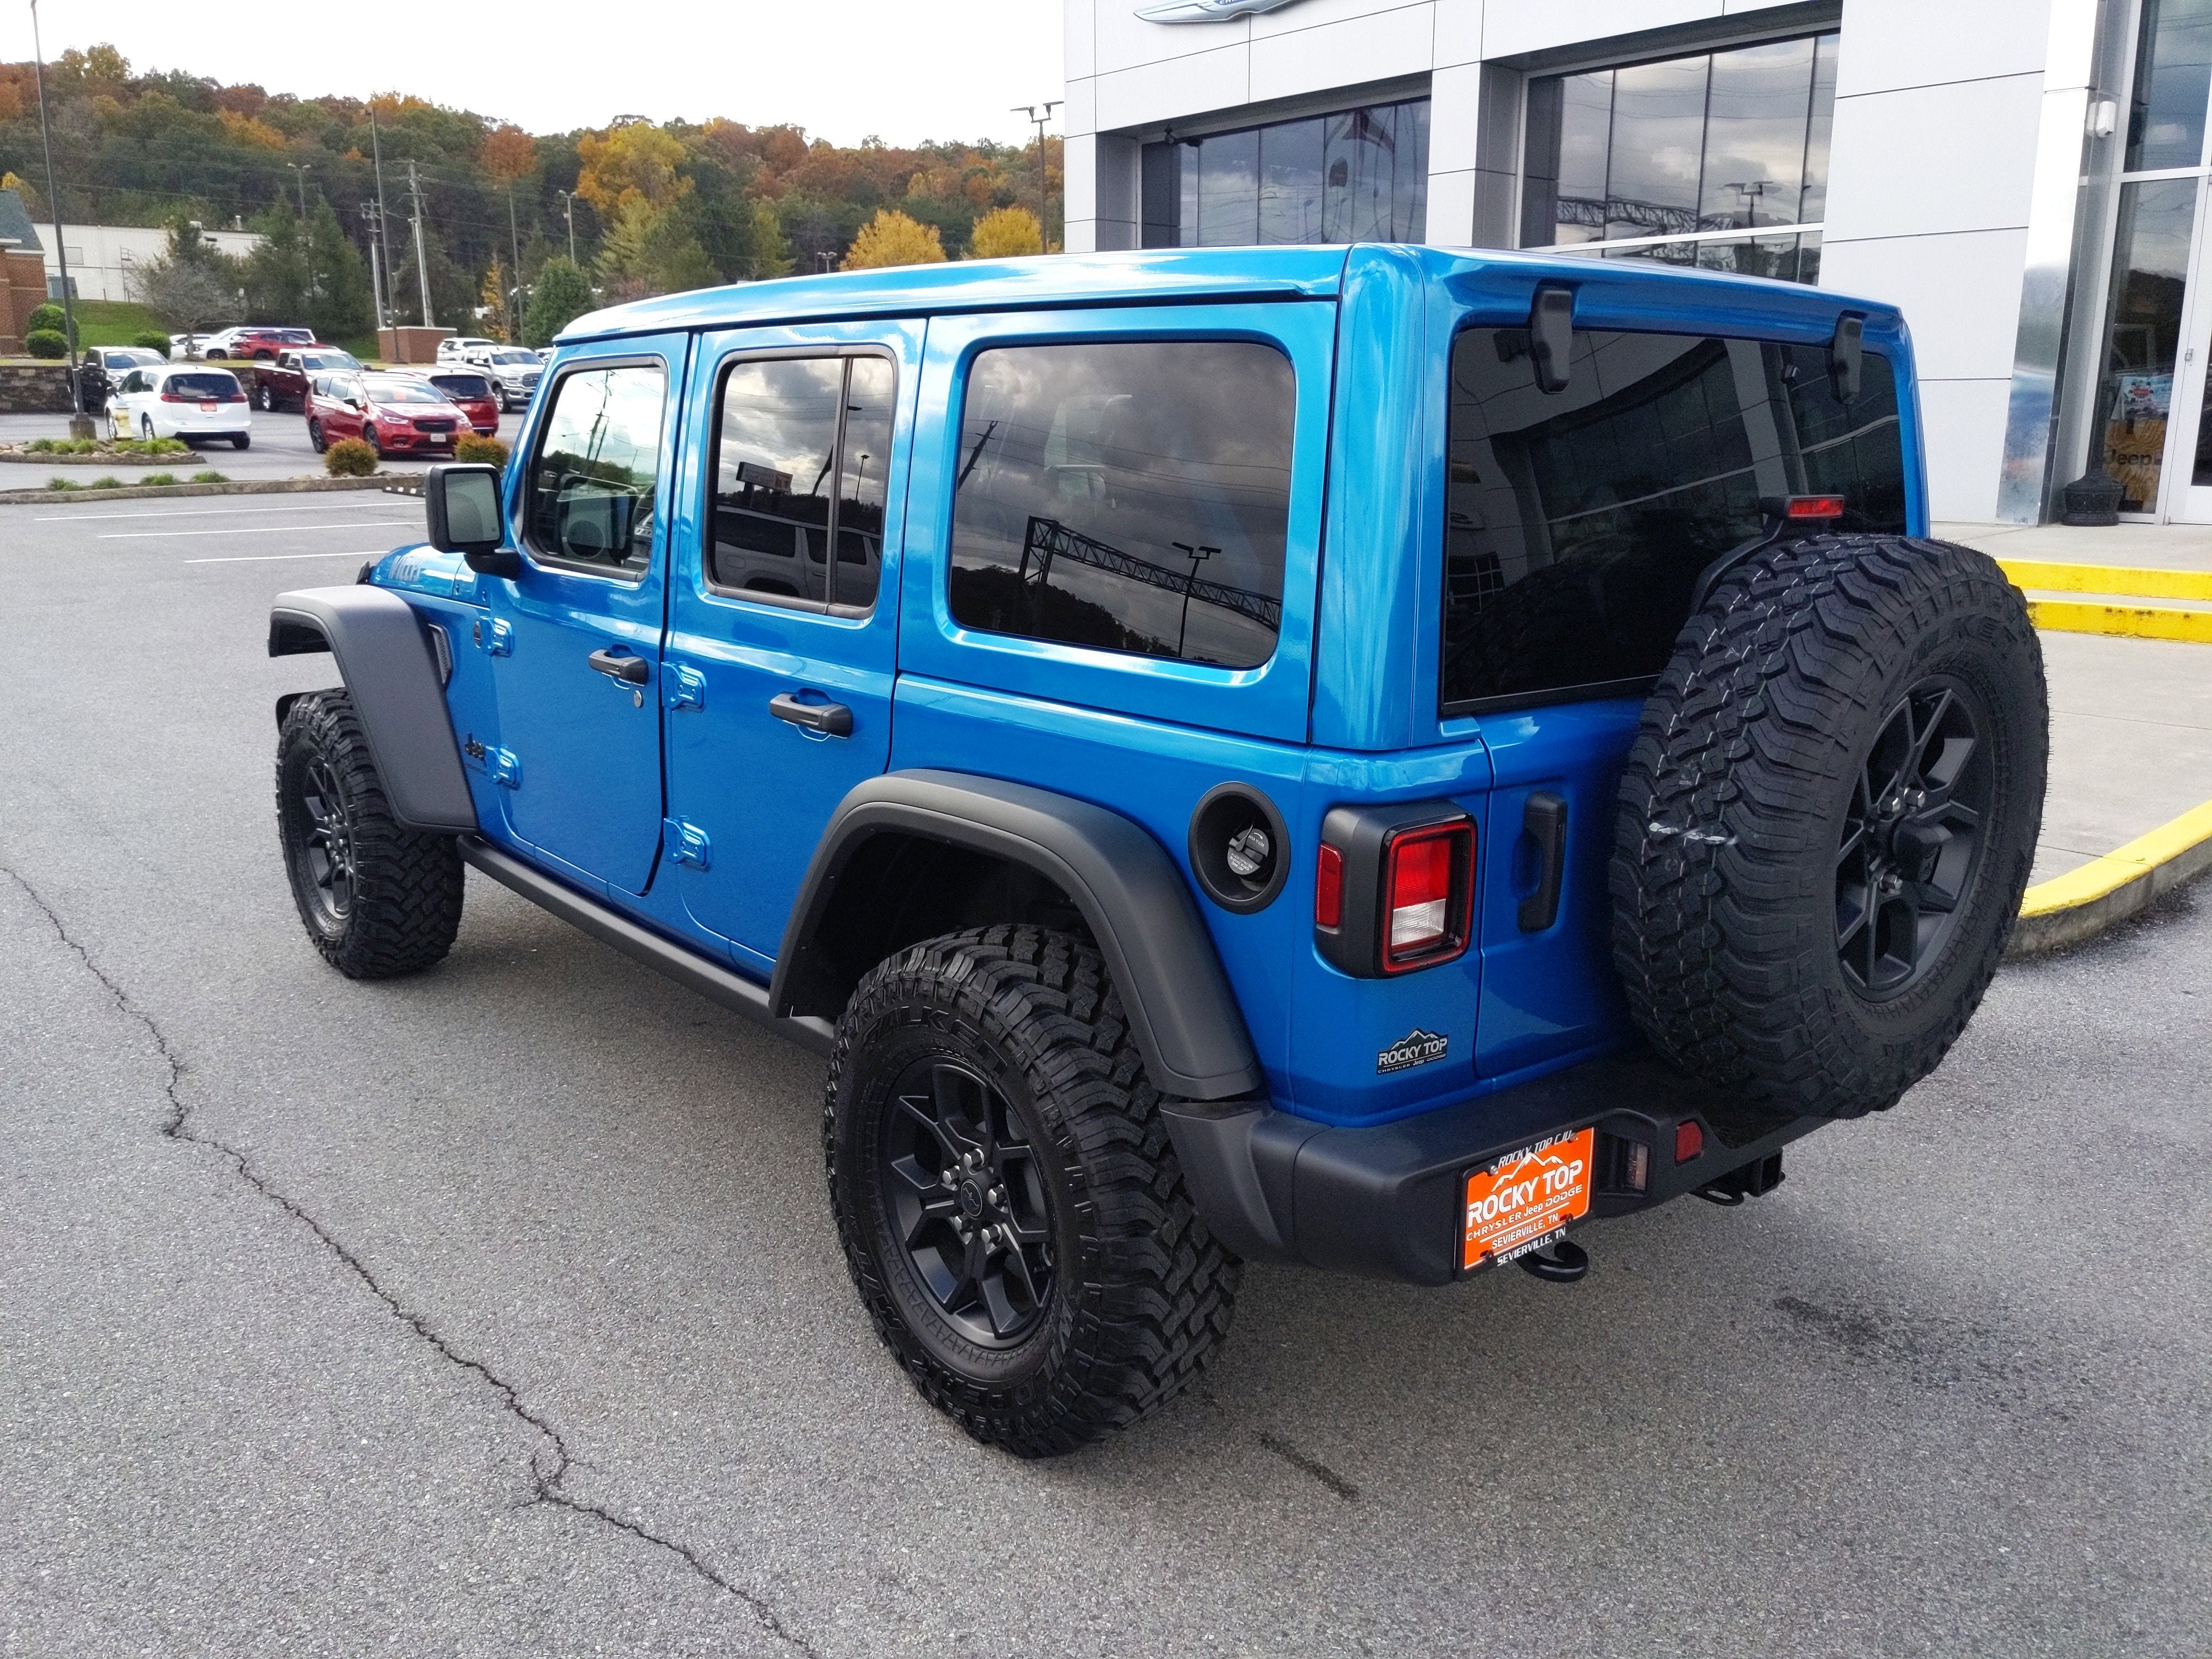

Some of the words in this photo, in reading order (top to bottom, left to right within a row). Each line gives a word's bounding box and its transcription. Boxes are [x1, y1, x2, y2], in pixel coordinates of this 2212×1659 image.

[860, 1005, 1008, 1077] FALKEN
[1378, 1044, 1421, 1065] ROCKY
[1423, 1037, 1448, 1054] TOP
[1498, 1145, 1532, 1169] ROCKY
[1534, 1137, 1553, 1154] TOP
[1466, 1212, 1521, 1242] CHRYSLER
[1523, 1203, 1543, 1219] Jeep
[1545, 1184, 1583, 1207] DODGE
[1468, 1176, 1539, 1228] ROCKY
[1543, 1159, 1583, 1195] TOP
[1492, 1219, 1545, 1250] SEVIERVILLE,
[1548, 1213, 1558, 1224] TN
[1497, 1234, 1553, 1266] SEVIERVILLE,
[1555, 1227, 1566, 1238] TN
